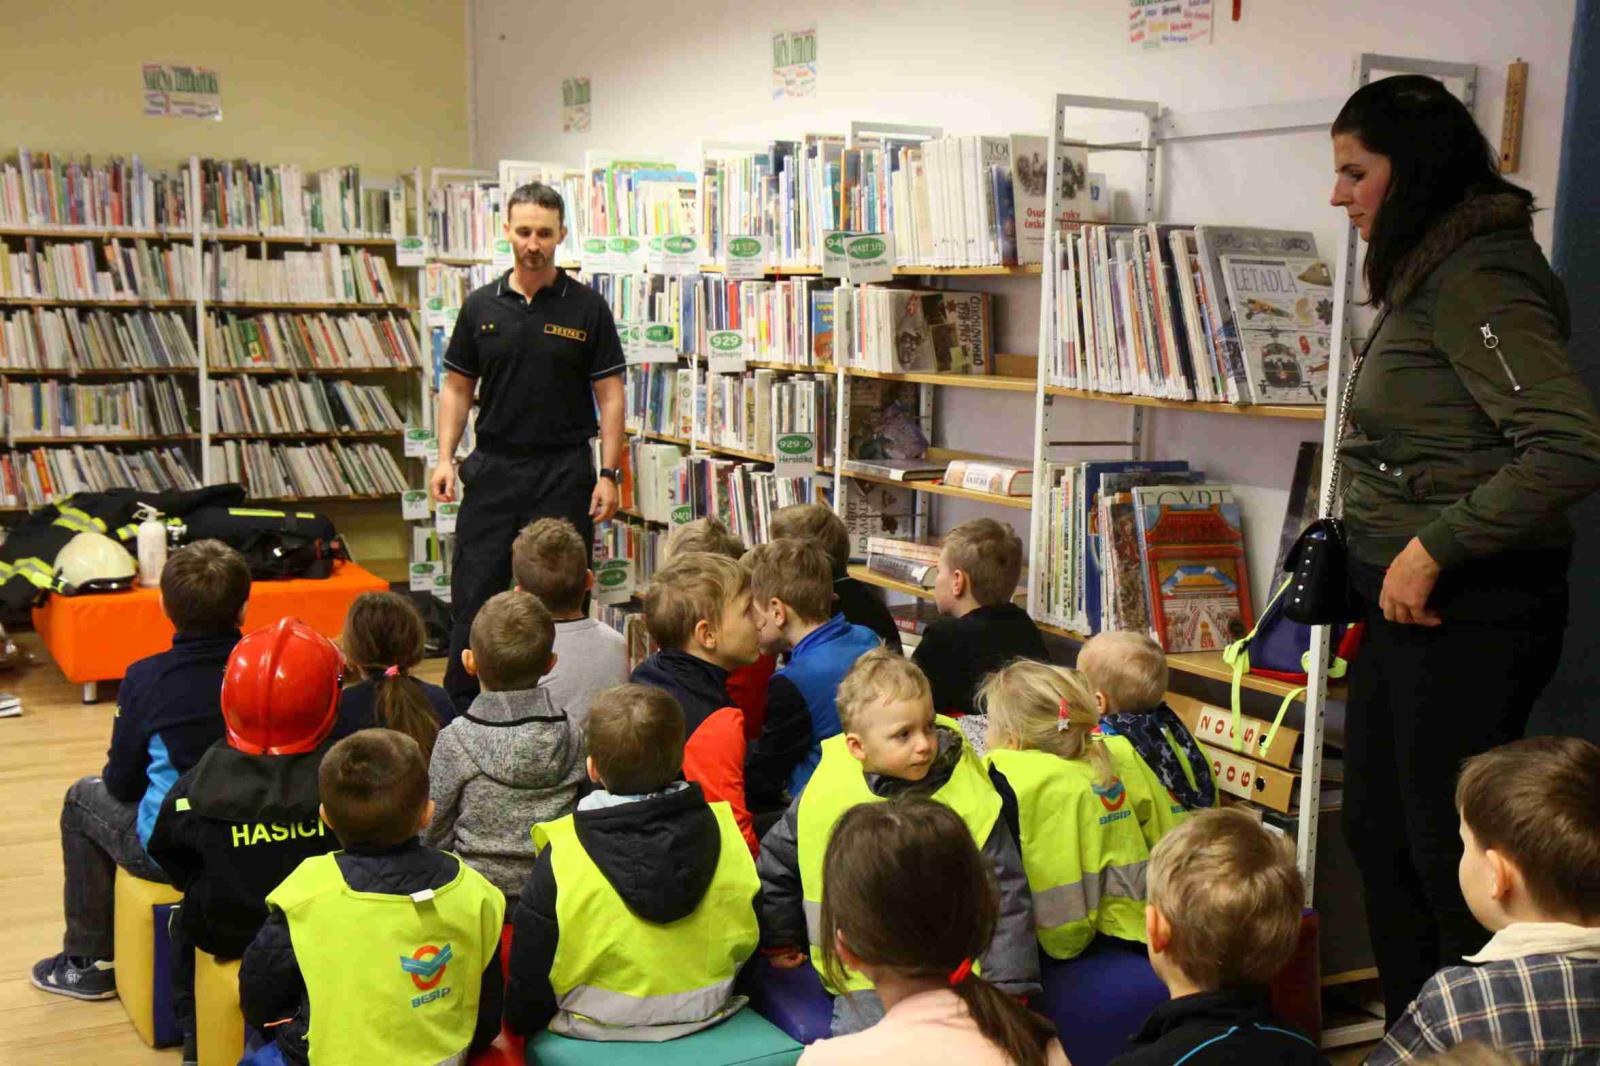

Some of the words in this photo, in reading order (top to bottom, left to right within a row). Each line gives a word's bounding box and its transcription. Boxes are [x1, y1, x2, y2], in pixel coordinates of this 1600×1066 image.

[1231, 267, 1299, 293] LETADLA
[713, 335, 739, 347] 929
[780, 440, 812, 449] 929.6
